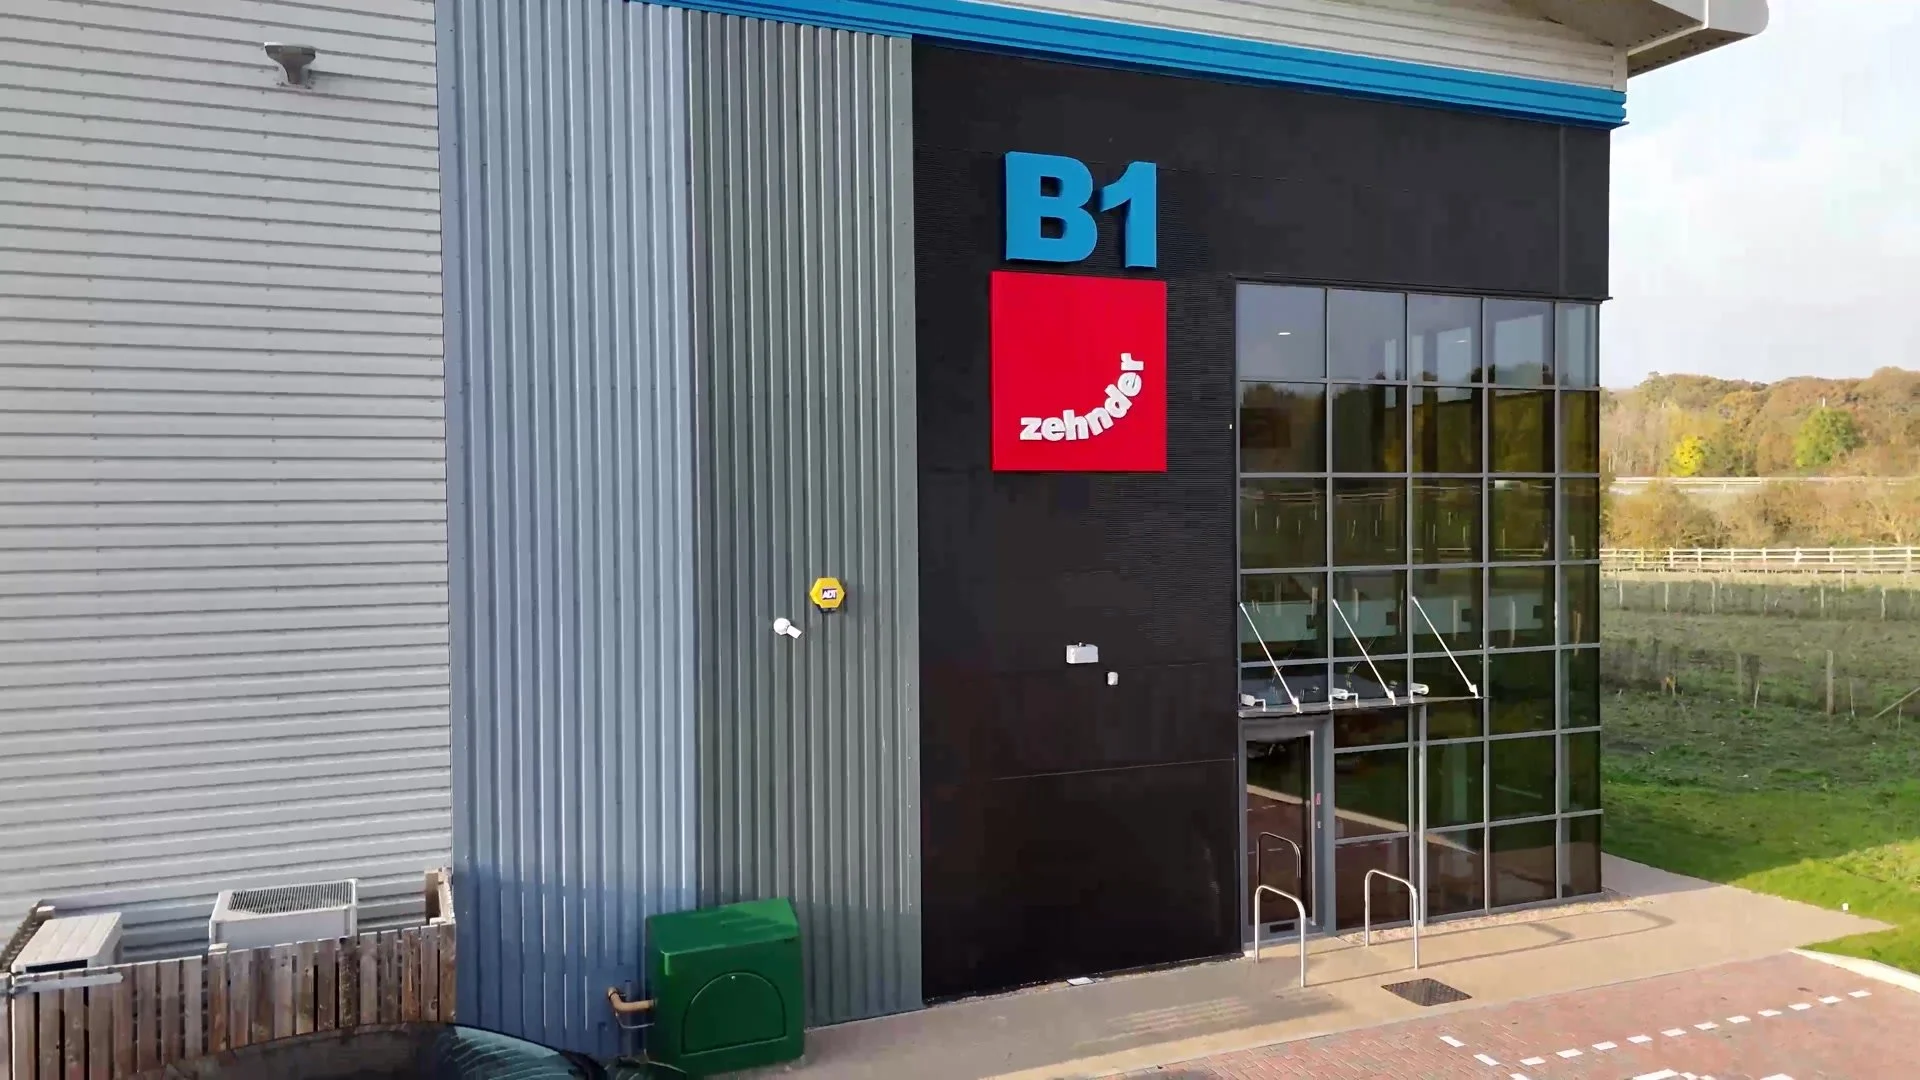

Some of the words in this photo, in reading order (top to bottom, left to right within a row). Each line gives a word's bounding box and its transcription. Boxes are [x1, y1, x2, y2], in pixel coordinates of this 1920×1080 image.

[1004, 150, 1158, 268] B1
[1019, 352, 1145, 442] zehnder
[822, 589, 837, 599] ADT
